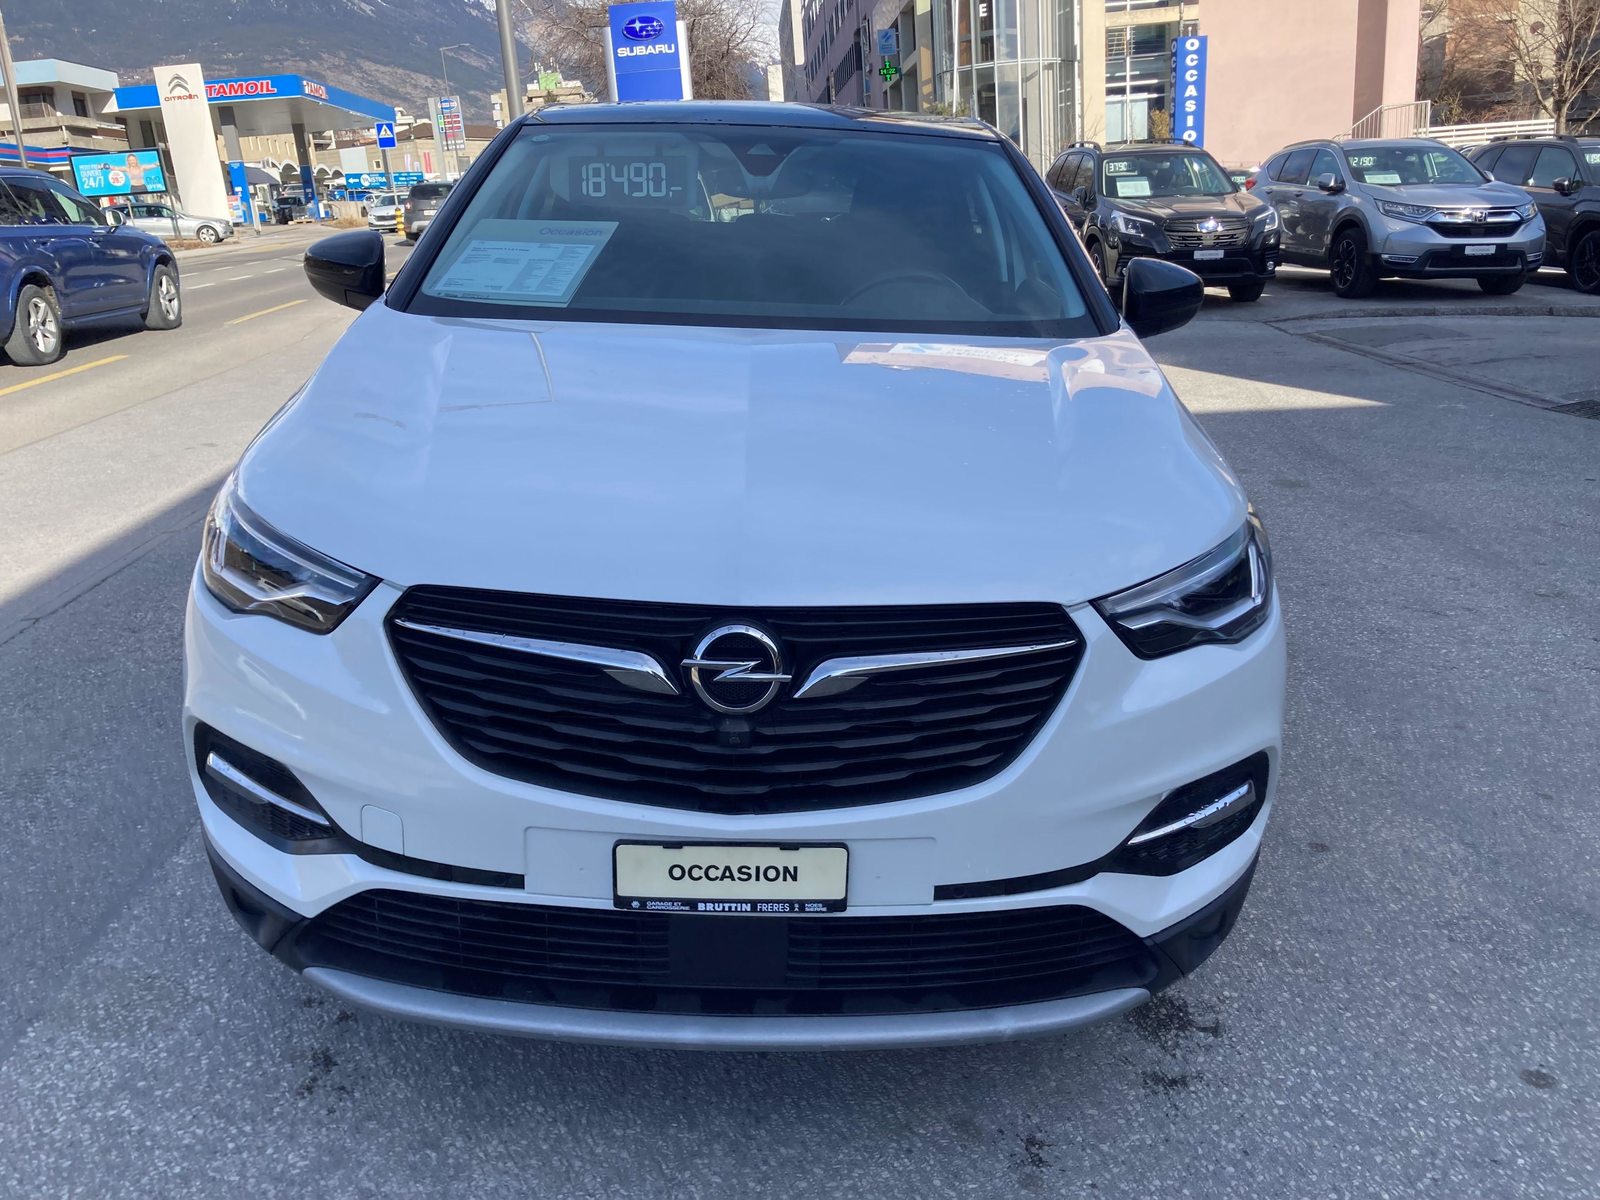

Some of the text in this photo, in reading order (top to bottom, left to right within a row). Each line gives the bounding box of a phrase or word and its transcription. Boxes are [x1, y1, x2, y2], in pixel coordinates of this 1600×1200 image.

[617, 43, 675, 57] SUBARU
[205, 80, 277, 97] TAMOIL
[82, 176, 105, 188] 24/7
[539, 227, 603, 236] Occasion
[710, 626, 764, 640] OPEL
[668, 864, 799, 882] OCCASION
[697, 902, 751, 912] BRUTTIN
